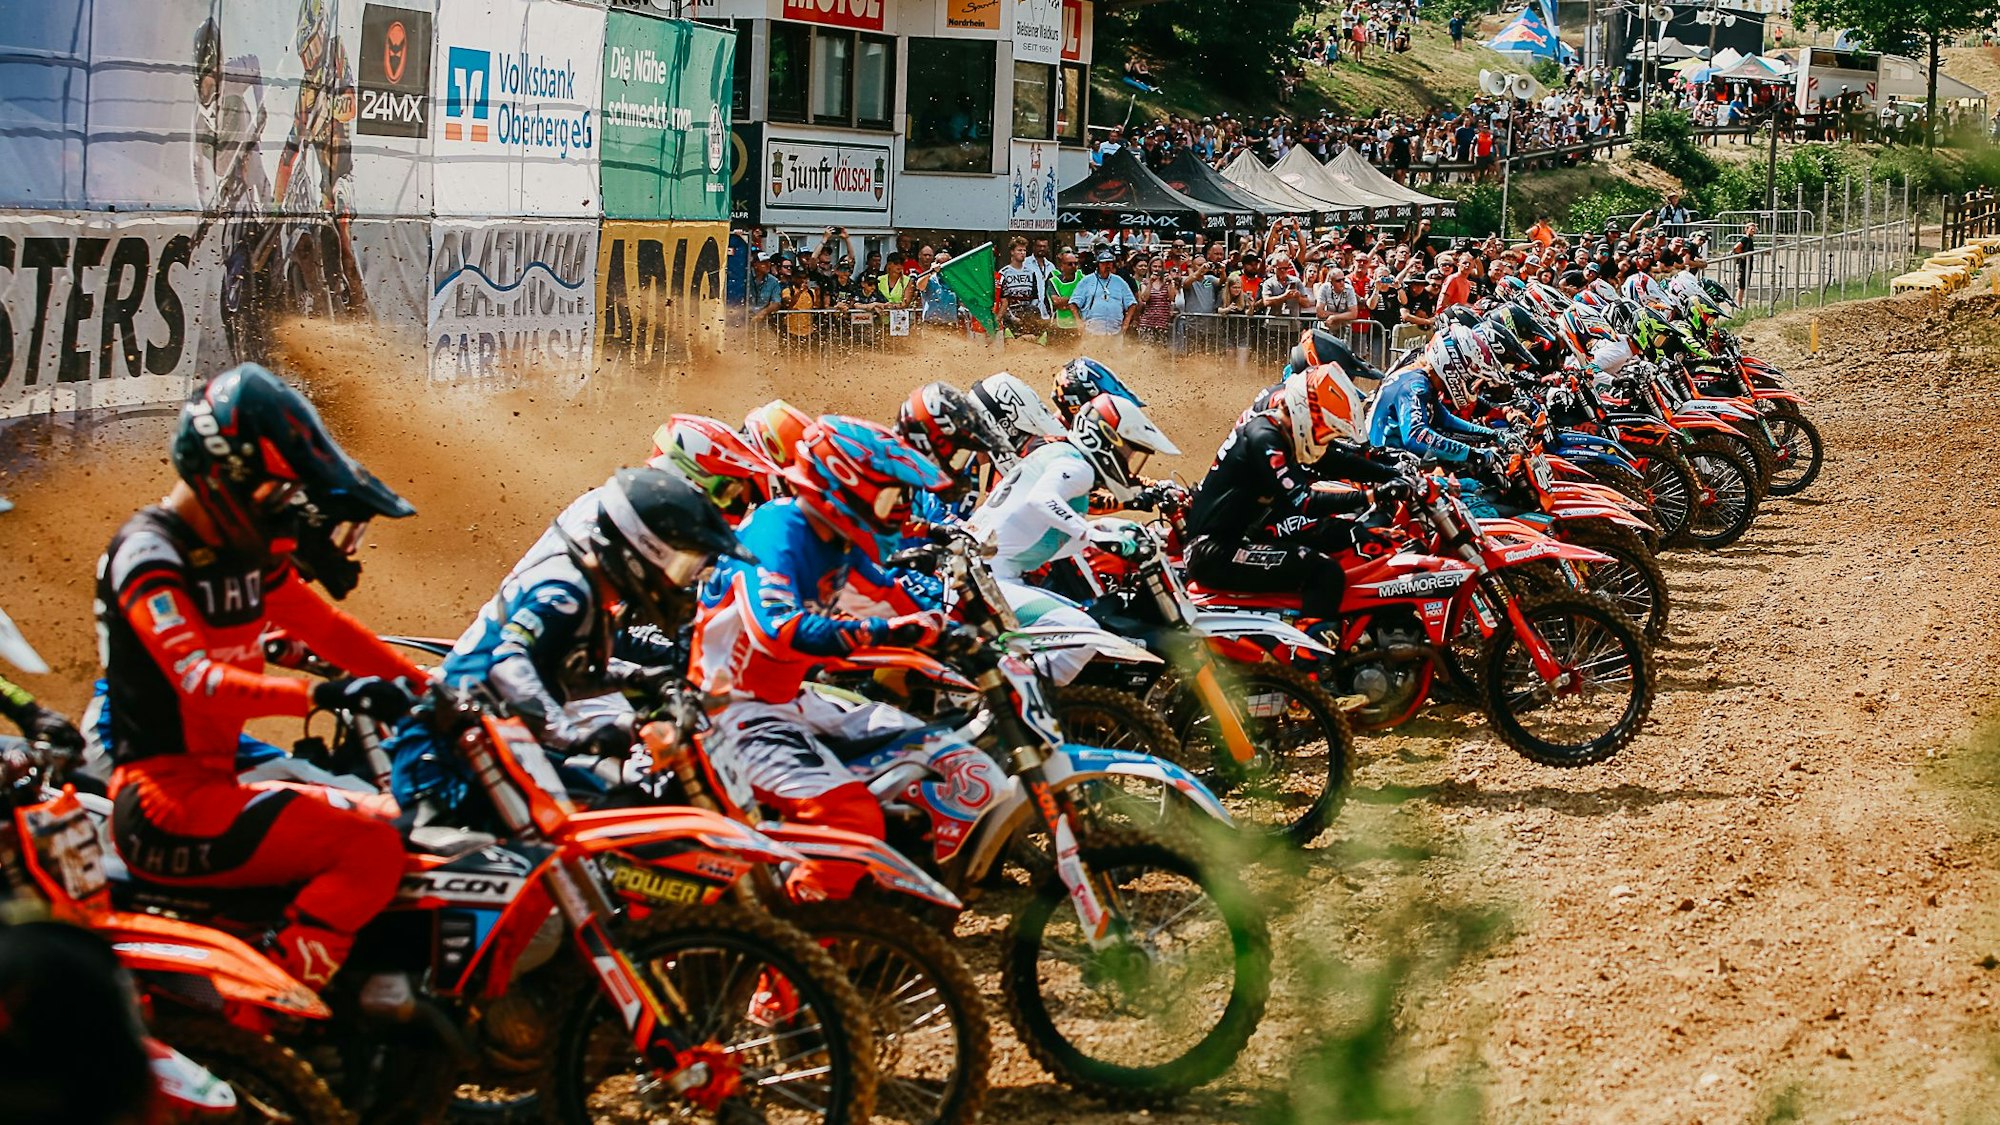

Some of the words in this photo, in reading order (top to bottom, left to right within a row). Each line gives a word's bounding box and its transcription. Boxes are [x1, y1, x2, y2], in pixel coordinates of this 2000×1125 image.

[948, 18, 985, 28] Nordrhein
[1022, 43, 1038, 51] SEIT
[1039, 45, 1052, 53] 1951
[610, 46, 631, 80] Die
[633, 49, 667, 85] Nähe
[498, 52, 576, 101] Volksbank
[362, 90, 424, 123] 24MX
[608, 93, 669, 130] schmeckt
[497, 103, 568, 159] Oberberg
[571, 110, 592, 149] eG
[787, 154, 832, 196] Zunft
[833, 159, 871, 192] KÖLSCH
[1324, 211, 1341, 223] 24MX
[1348, 210, 1364, 221] 24MX
[1374, 207, 1390, 220] 24MX
[1396, 207, 1412, 217] 24MX
[1421, 206, 1436, 217] 24MX
[1120, 213, 1180, 227] 24MX
[1207, 215, 1227, 228] 24MX
[1235, 215, 1253, 226] 24MX
[1378, 573, 1463, 598] MARMOREST
[613, 865, 700, 905] POWER
